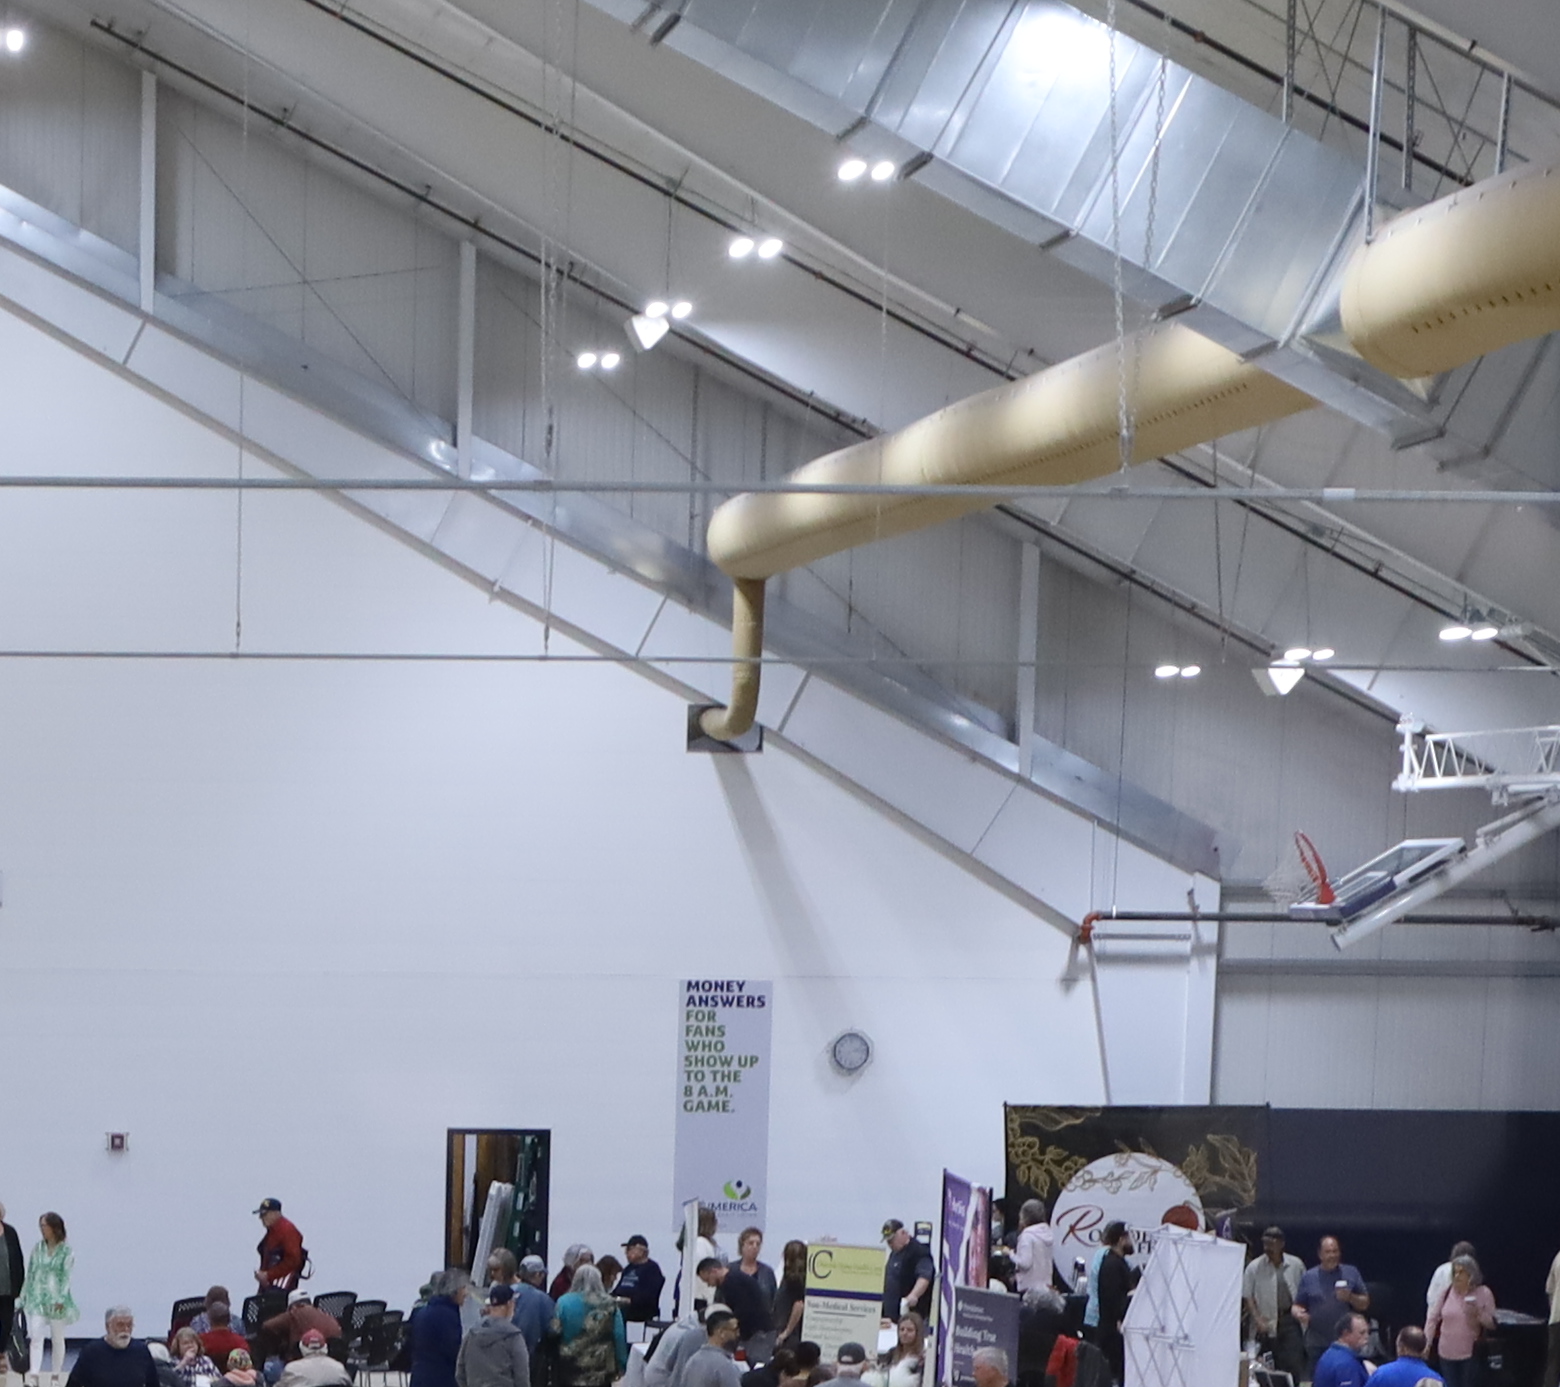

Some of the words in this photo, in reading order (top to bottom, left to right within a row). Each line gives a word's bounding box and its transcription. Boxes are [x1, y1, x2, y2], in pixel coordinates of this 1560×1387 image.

[686, 980, 746, 993] MONEY
[685, 995, 766, 1008] ANSWERS
[685, 1010, 716, 1022] FOR
[685, 1025, 726, 1038] FANS
[684, 1040, 725, 1052] WHO
[684, 1055, 734, 1068] SHOW
[738, 1055, 759, 1068] UP
[685, 1070, 706, 1083] TO
[710, 1070, 742, 1083] THE
[683, 1085, 693, 1098] 8
[697, 1085, 733, 1098] A.M.
[683, 1100, 735, 1113] GAME.
[850, 1302, 876, 1313] Services
